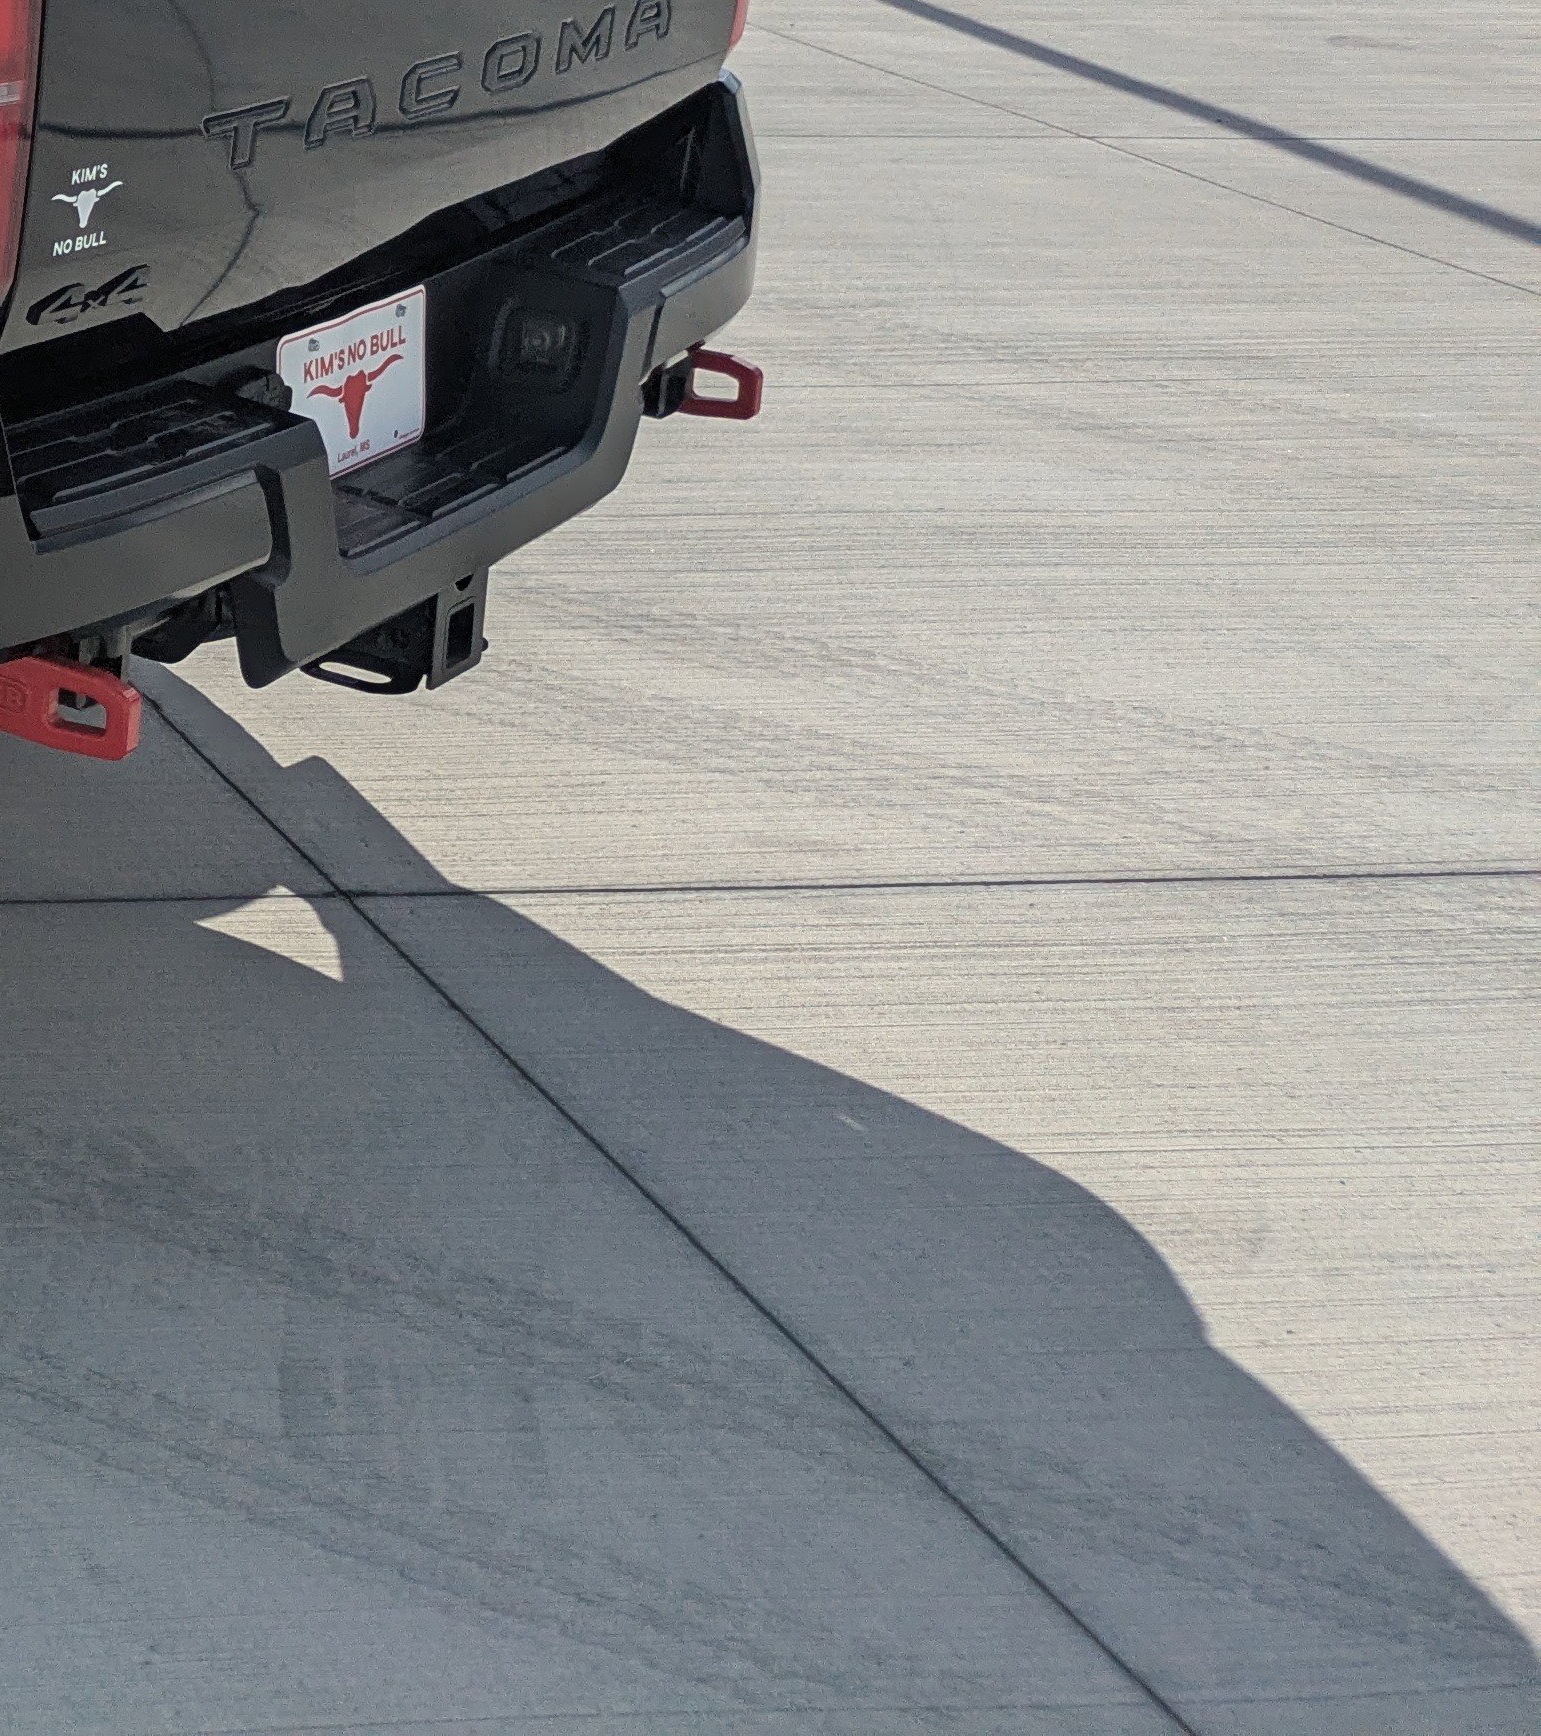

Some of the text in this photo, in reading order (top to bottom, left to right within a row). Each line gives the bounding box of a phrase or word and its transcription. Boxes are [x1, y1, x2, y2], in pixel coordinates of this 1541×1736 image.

[71, 163, 108, 185] KIM'S
[52, 230, 107, 257] NO BULL
[303, 325, 406, 383] KIM'S NO BULL
